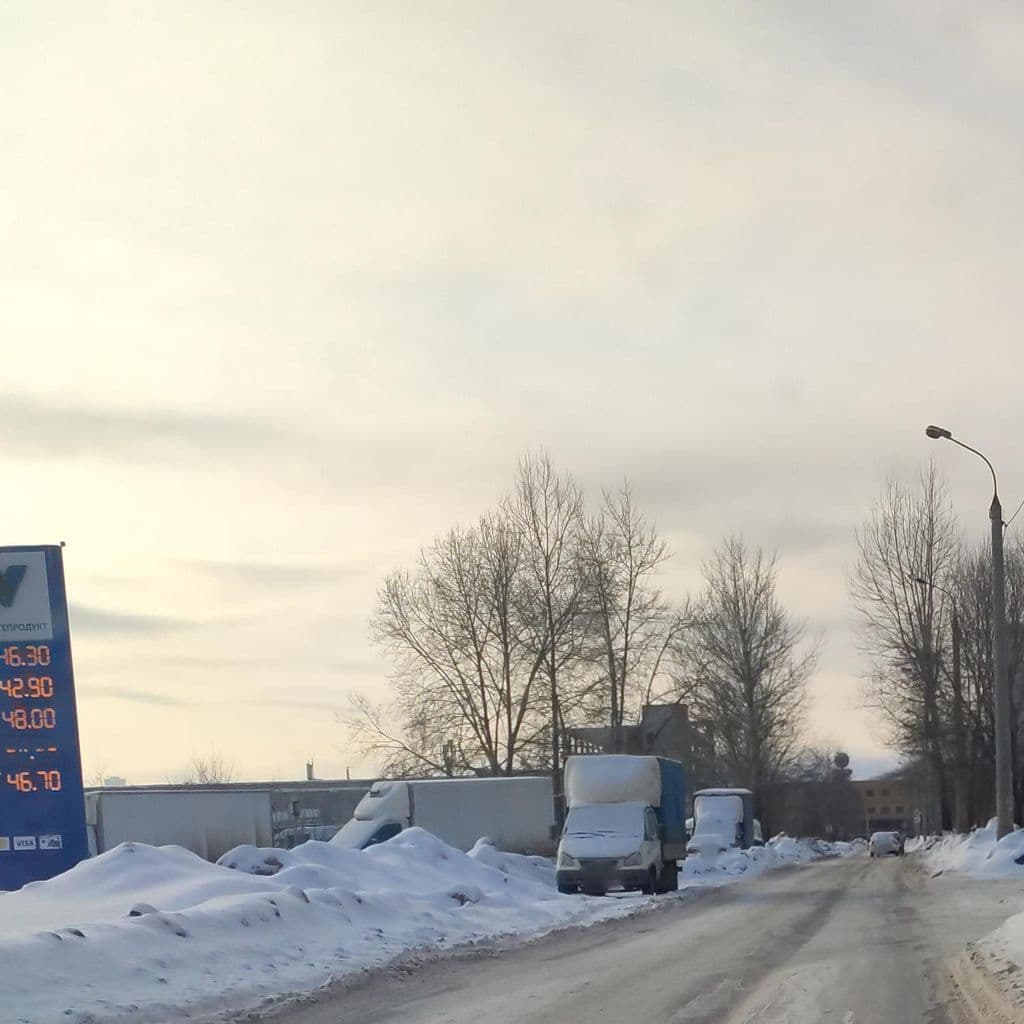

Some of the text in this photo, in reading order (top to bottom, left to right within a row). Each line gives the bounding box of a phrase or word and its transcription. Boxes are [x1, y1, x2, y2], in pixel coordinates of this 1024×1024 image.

[0, 676, 54, 698] 42.90
[2, 708, 56, 730] 48.00
[7, 770, 61, 792] 46.70
[16, 839, 34, 847] VISA
